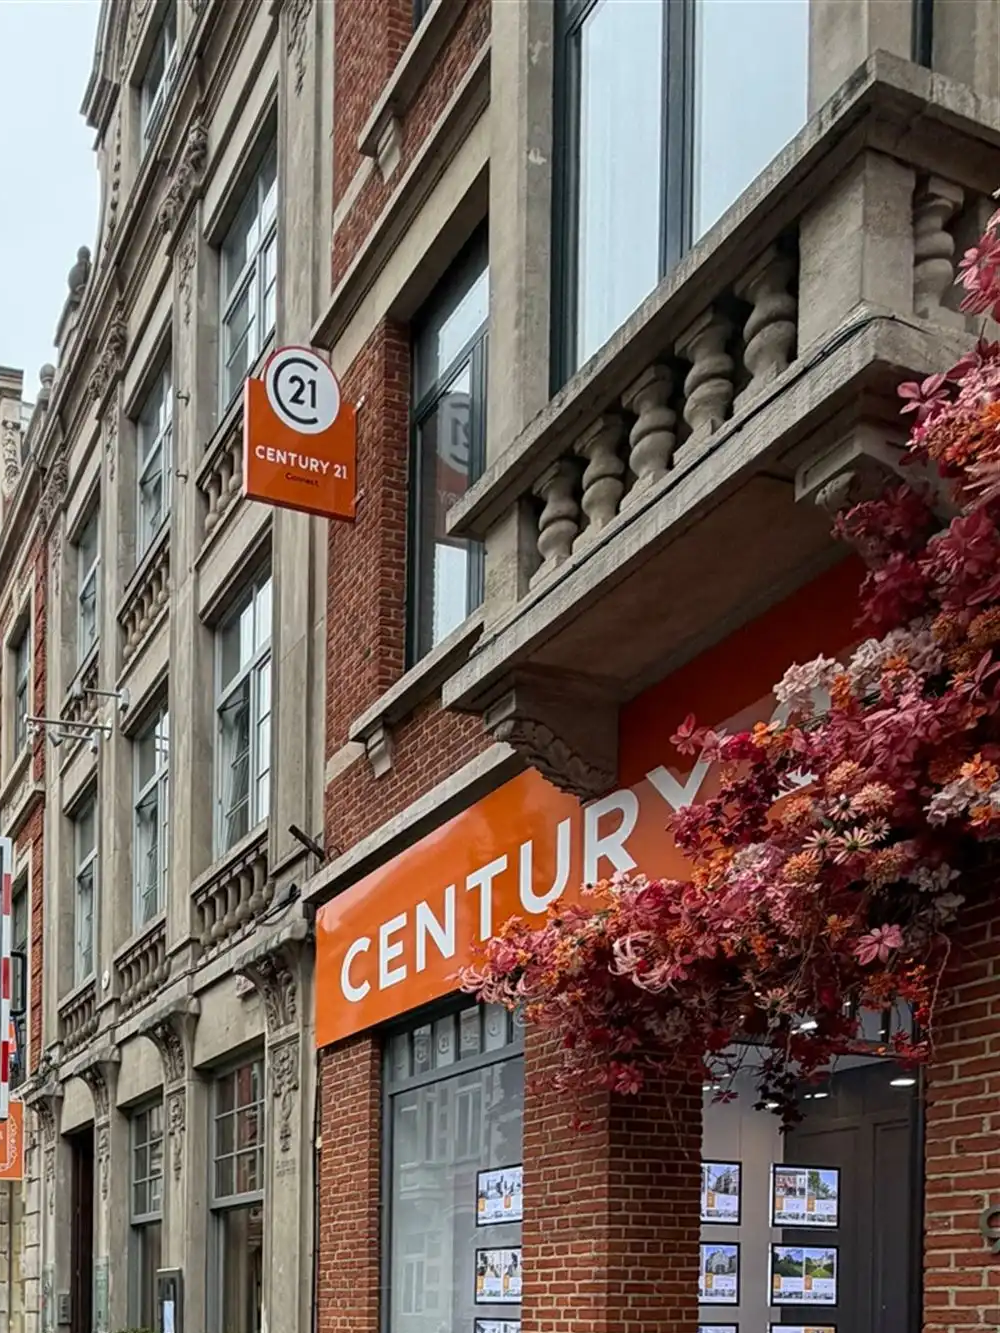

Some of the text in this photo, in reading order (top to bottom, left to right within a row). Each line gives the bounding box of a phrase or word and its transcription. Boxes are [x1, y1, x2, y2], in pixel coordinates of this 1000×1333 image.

[255, 445, 348, 480] CENTURY 21
[340, 728, 727, 1002] CENTURY
